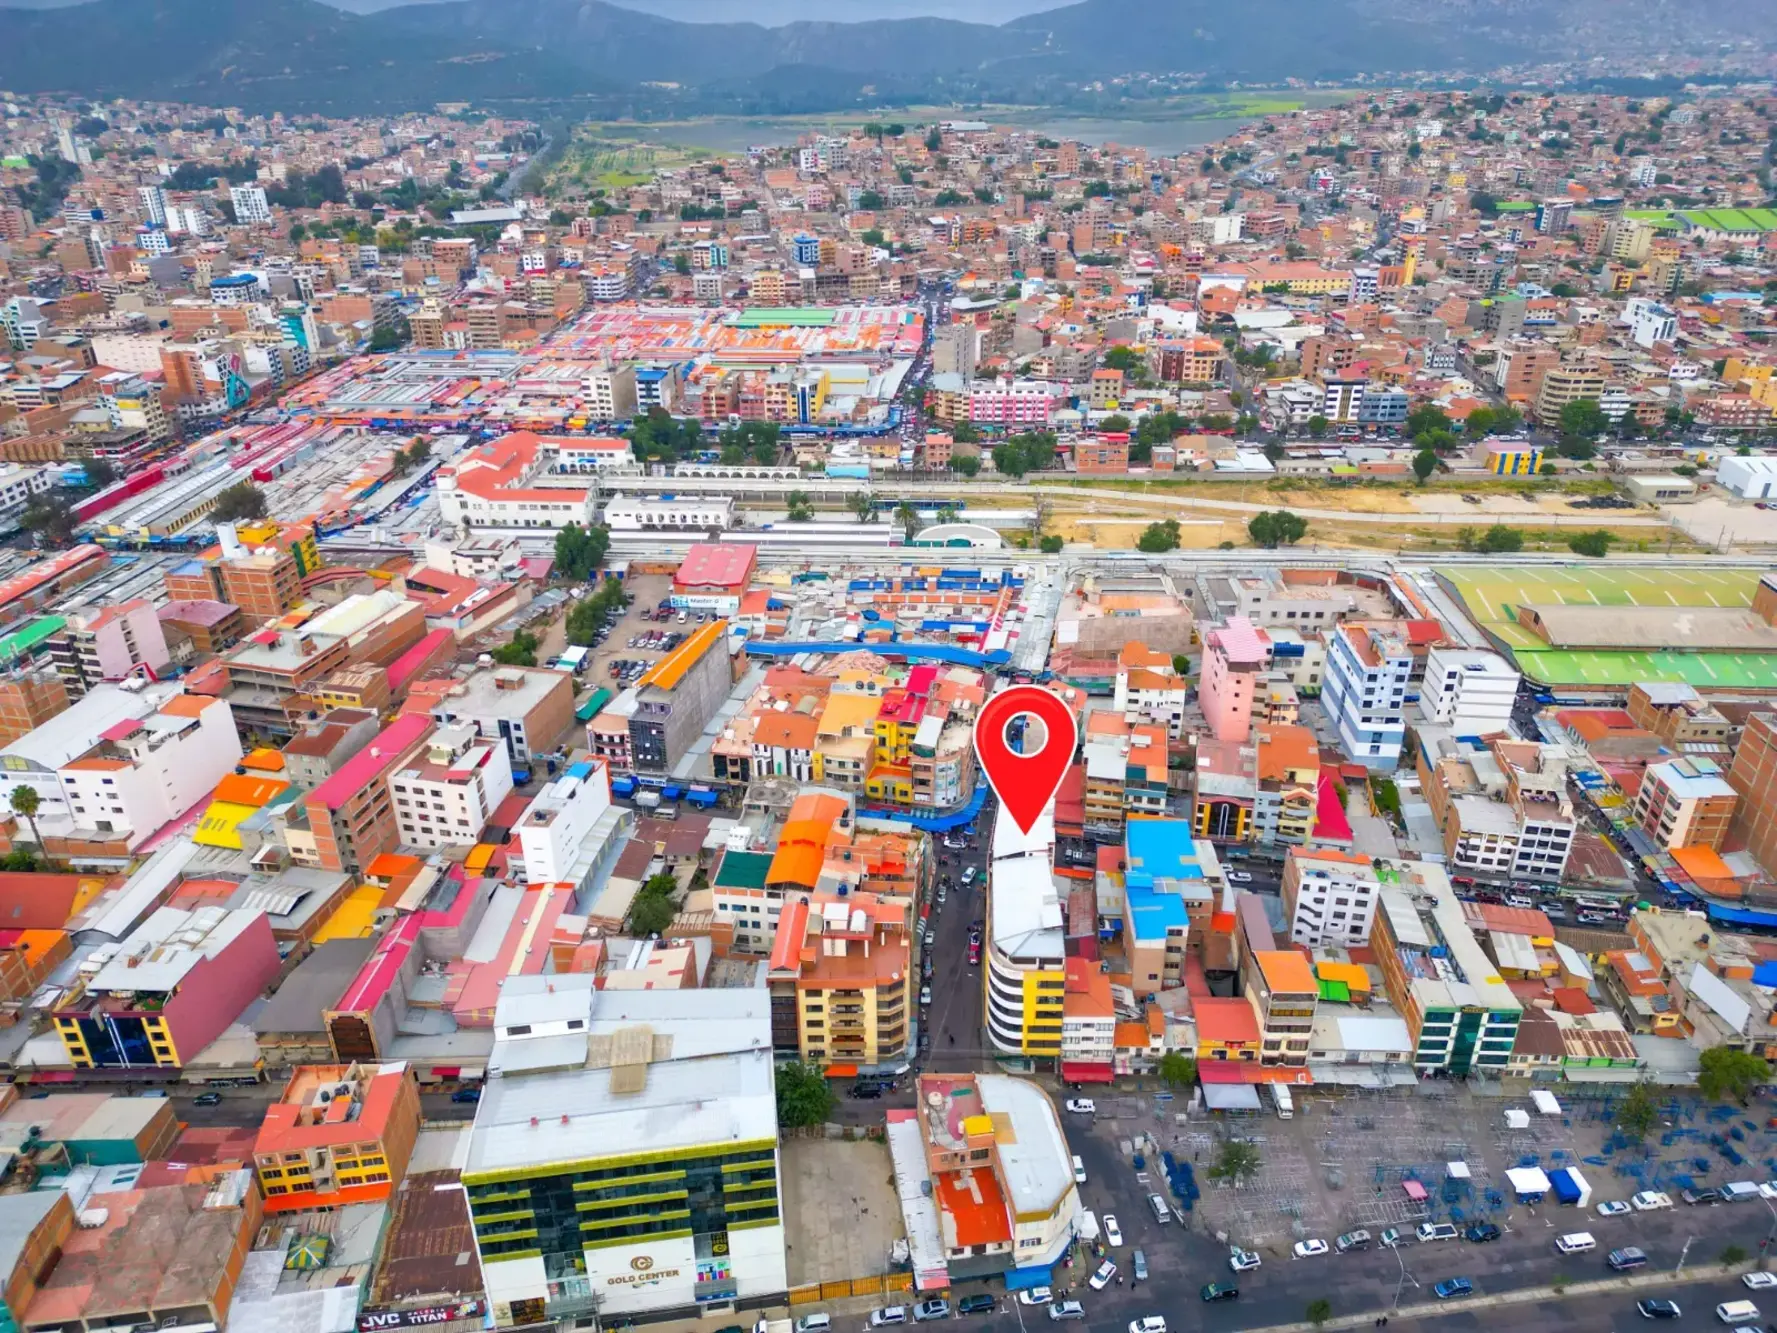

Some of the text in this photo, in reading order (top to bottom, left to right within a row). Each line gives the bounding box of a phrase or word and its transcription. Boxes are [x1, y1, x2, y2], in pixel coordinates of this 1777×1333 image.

[607, 1269, 680, 1286] GOLD CENTER
[361, 1312, 401, 1328] JVC
[408, 1312, 448, 1324] TITAN
